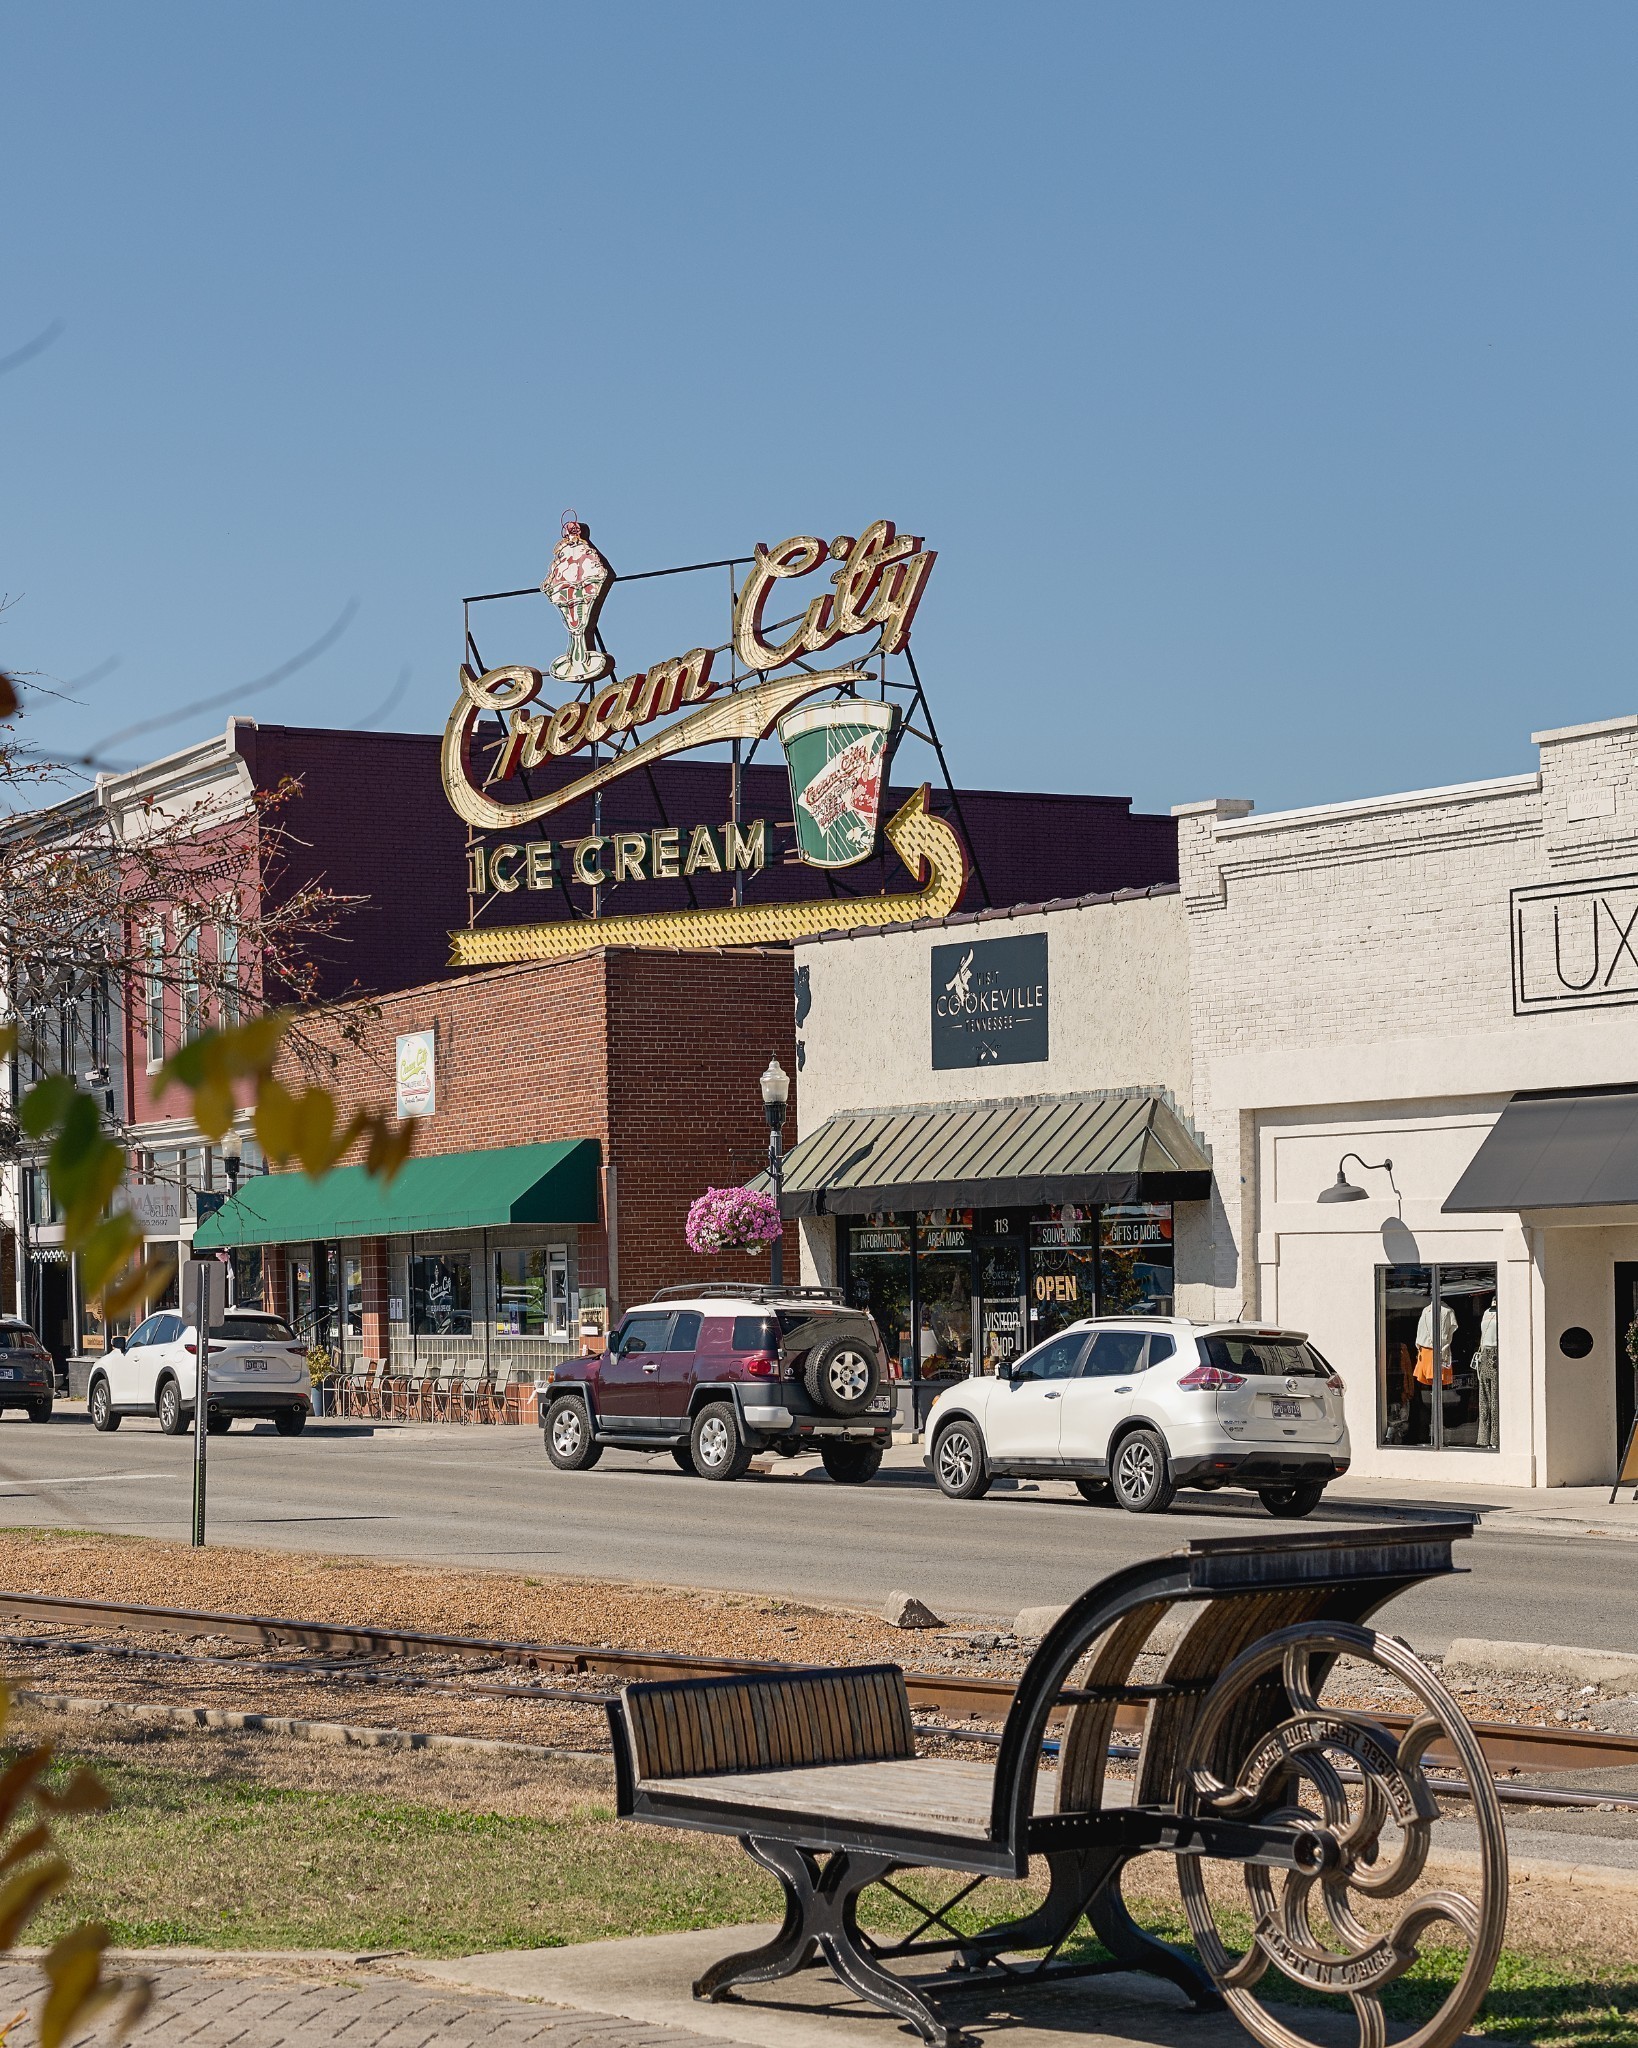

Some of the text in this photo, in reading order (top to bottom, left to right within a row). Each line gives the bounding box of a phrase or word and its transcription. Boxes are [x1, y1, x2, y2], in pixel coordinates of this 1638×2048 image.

[441, 519, 938, 829] Cream City
[474, 819, 768, 894] ICE CREAM
[976, 970, 999, 986] VISIT
[937, 985, 1043, 1017] COOKEVILLE
[965, 1015, 1013, 1032] TENNESSEE
[994, 1218, 1009, 1233] 113
[1111, 1224, 1162, 1241] GIFTS & MORE
[860, 1233, 902, 1249] INFORMATION
[927, 1231, 965, 1248] AREA MAPS
[1042, 1227, 1081, 1243] SOUVENIRS
[1035, 1275, 1078, 1301] OPEN
[1282, 1722, 1313, 1748] OUR
[1317, 1720, 1361, 1749] REST
[1314, 1962, 1334, 1984] IN
